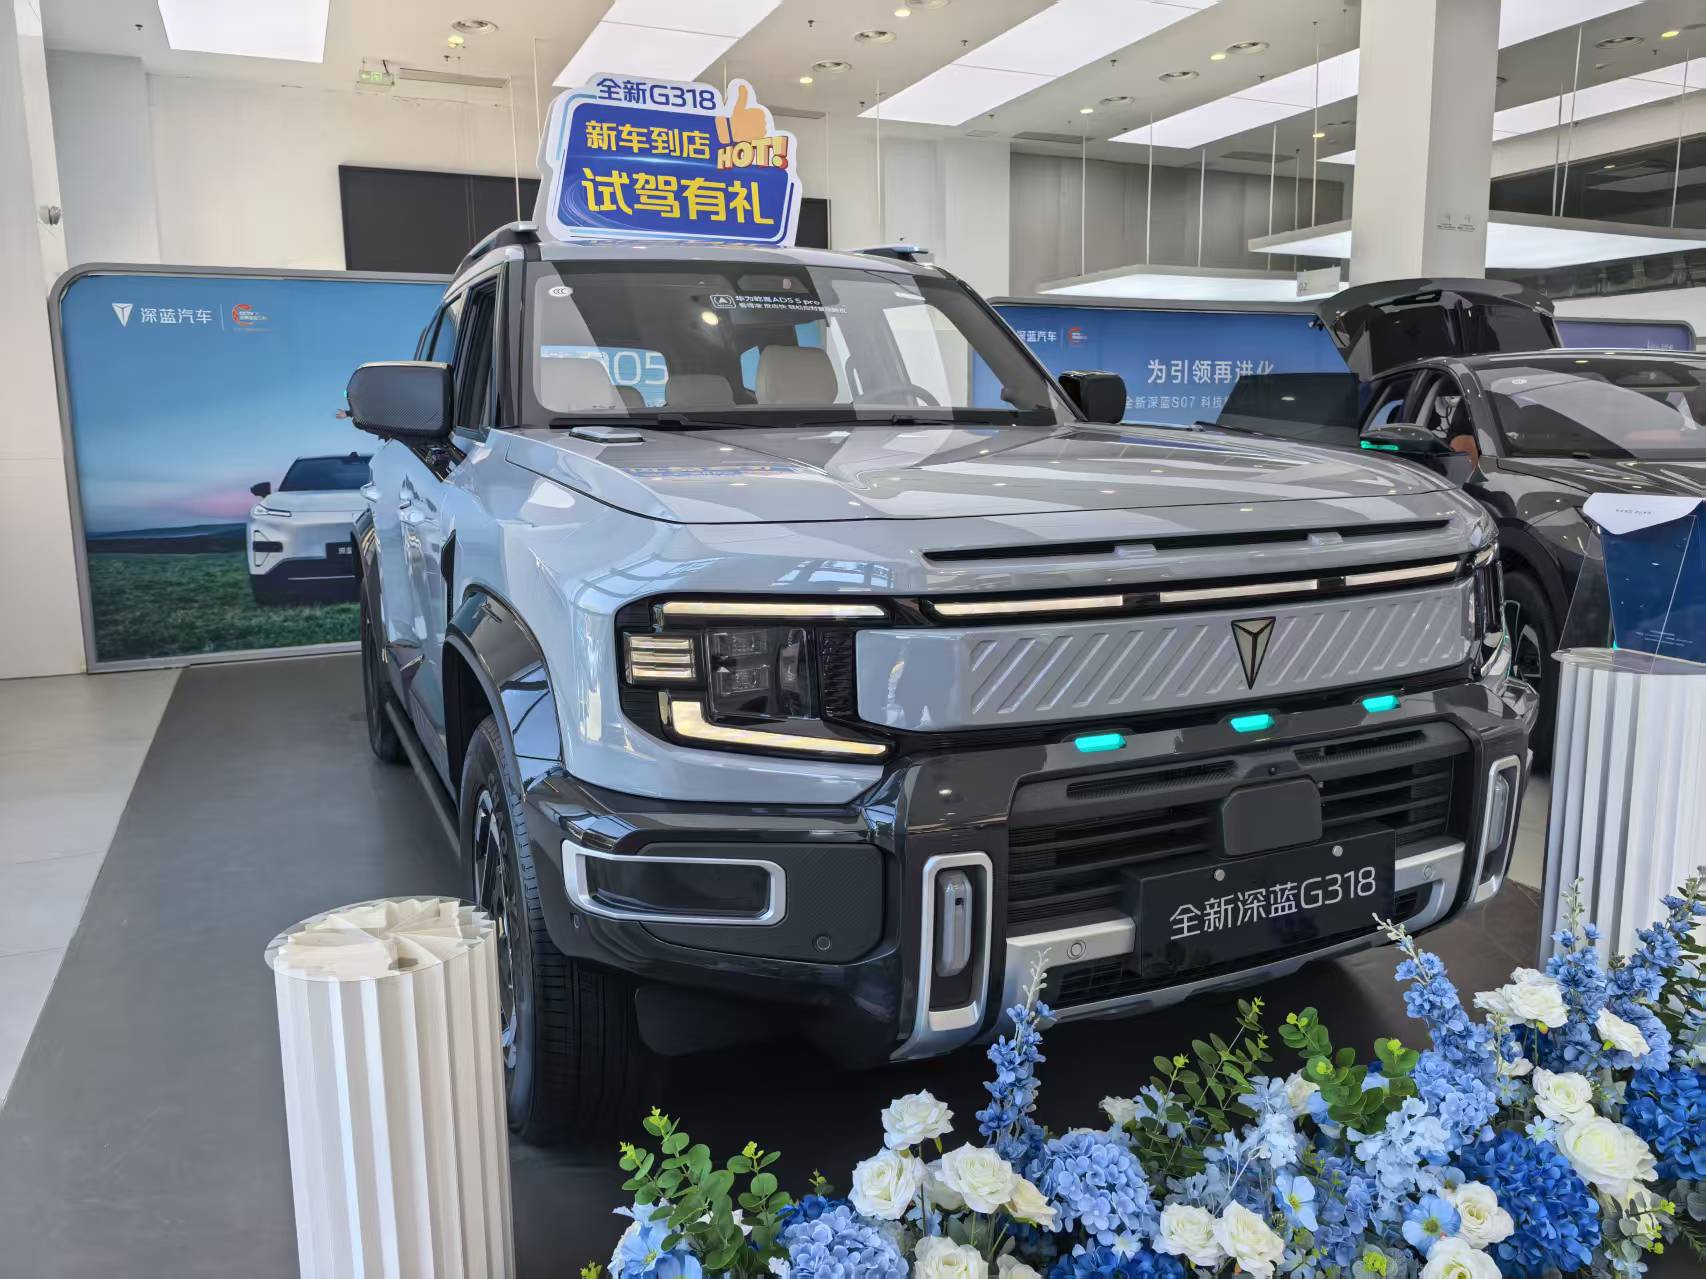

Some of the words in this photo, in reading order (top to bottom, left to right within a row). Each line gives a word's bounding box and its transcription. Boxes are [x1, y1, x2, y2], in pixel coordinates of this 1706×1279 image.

[596, 78, 716, 110] 全新G318
[585, 120, 710, 160] 新车到店
[717, 135, 788, 170] HOT!
[582, 167, 774, 225] 试驾有礼
[140, 307, 213, 324] 深蓝汽车
[1200, 393, 1230, 409] 科技
[1169, 866, 1376, 941] 全新深蓝G318
